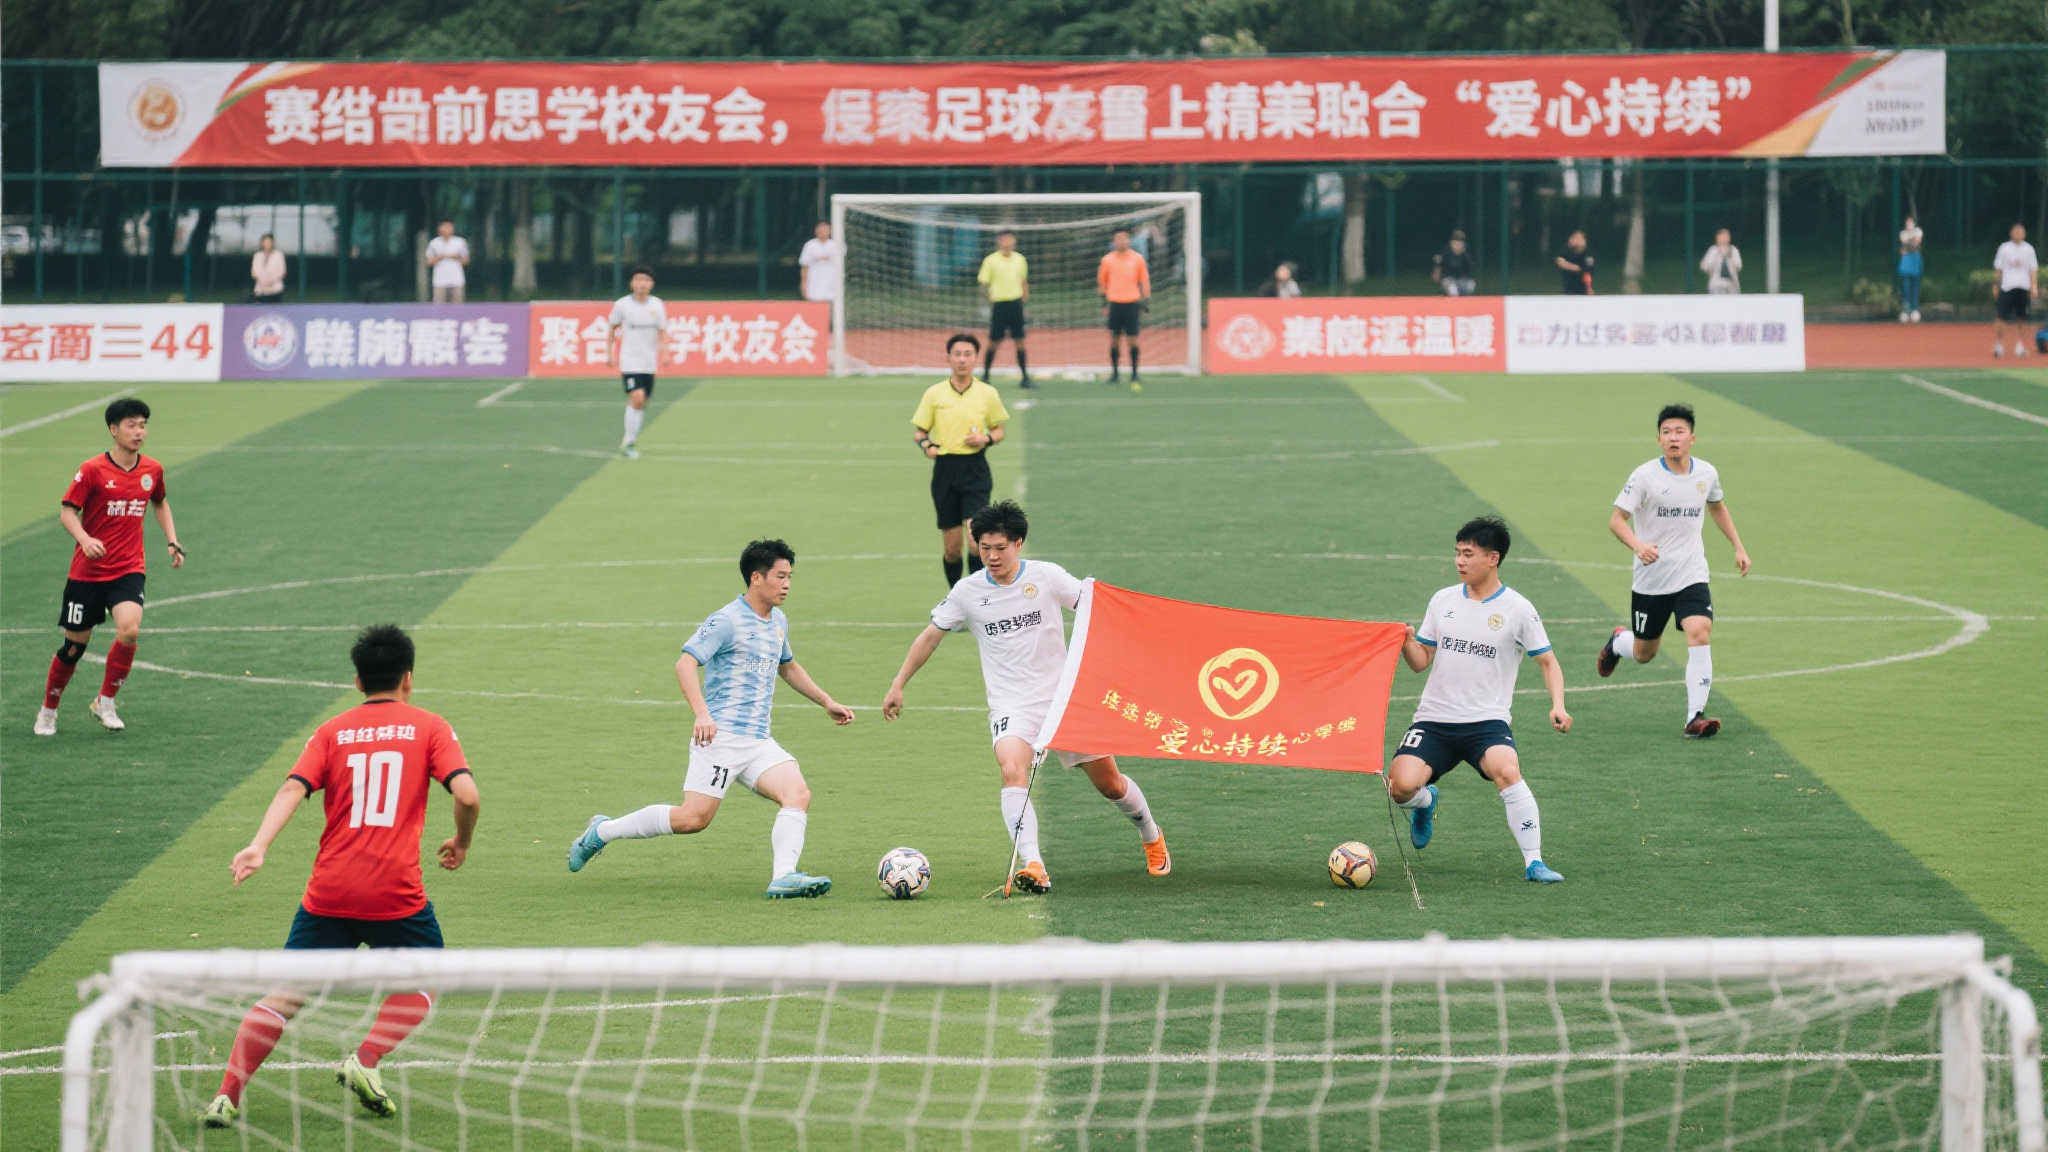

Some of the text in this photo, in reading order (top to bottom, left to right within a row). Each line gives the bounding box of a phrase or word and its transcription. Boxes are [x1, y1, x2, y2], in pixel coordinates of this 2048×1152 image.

[540, 314, 819, 365] 聚合学校友会
[67, 602, 84, 625] 16
[1635, 610, 1648, 633] 17
[346, 751, 404, 828] 10
